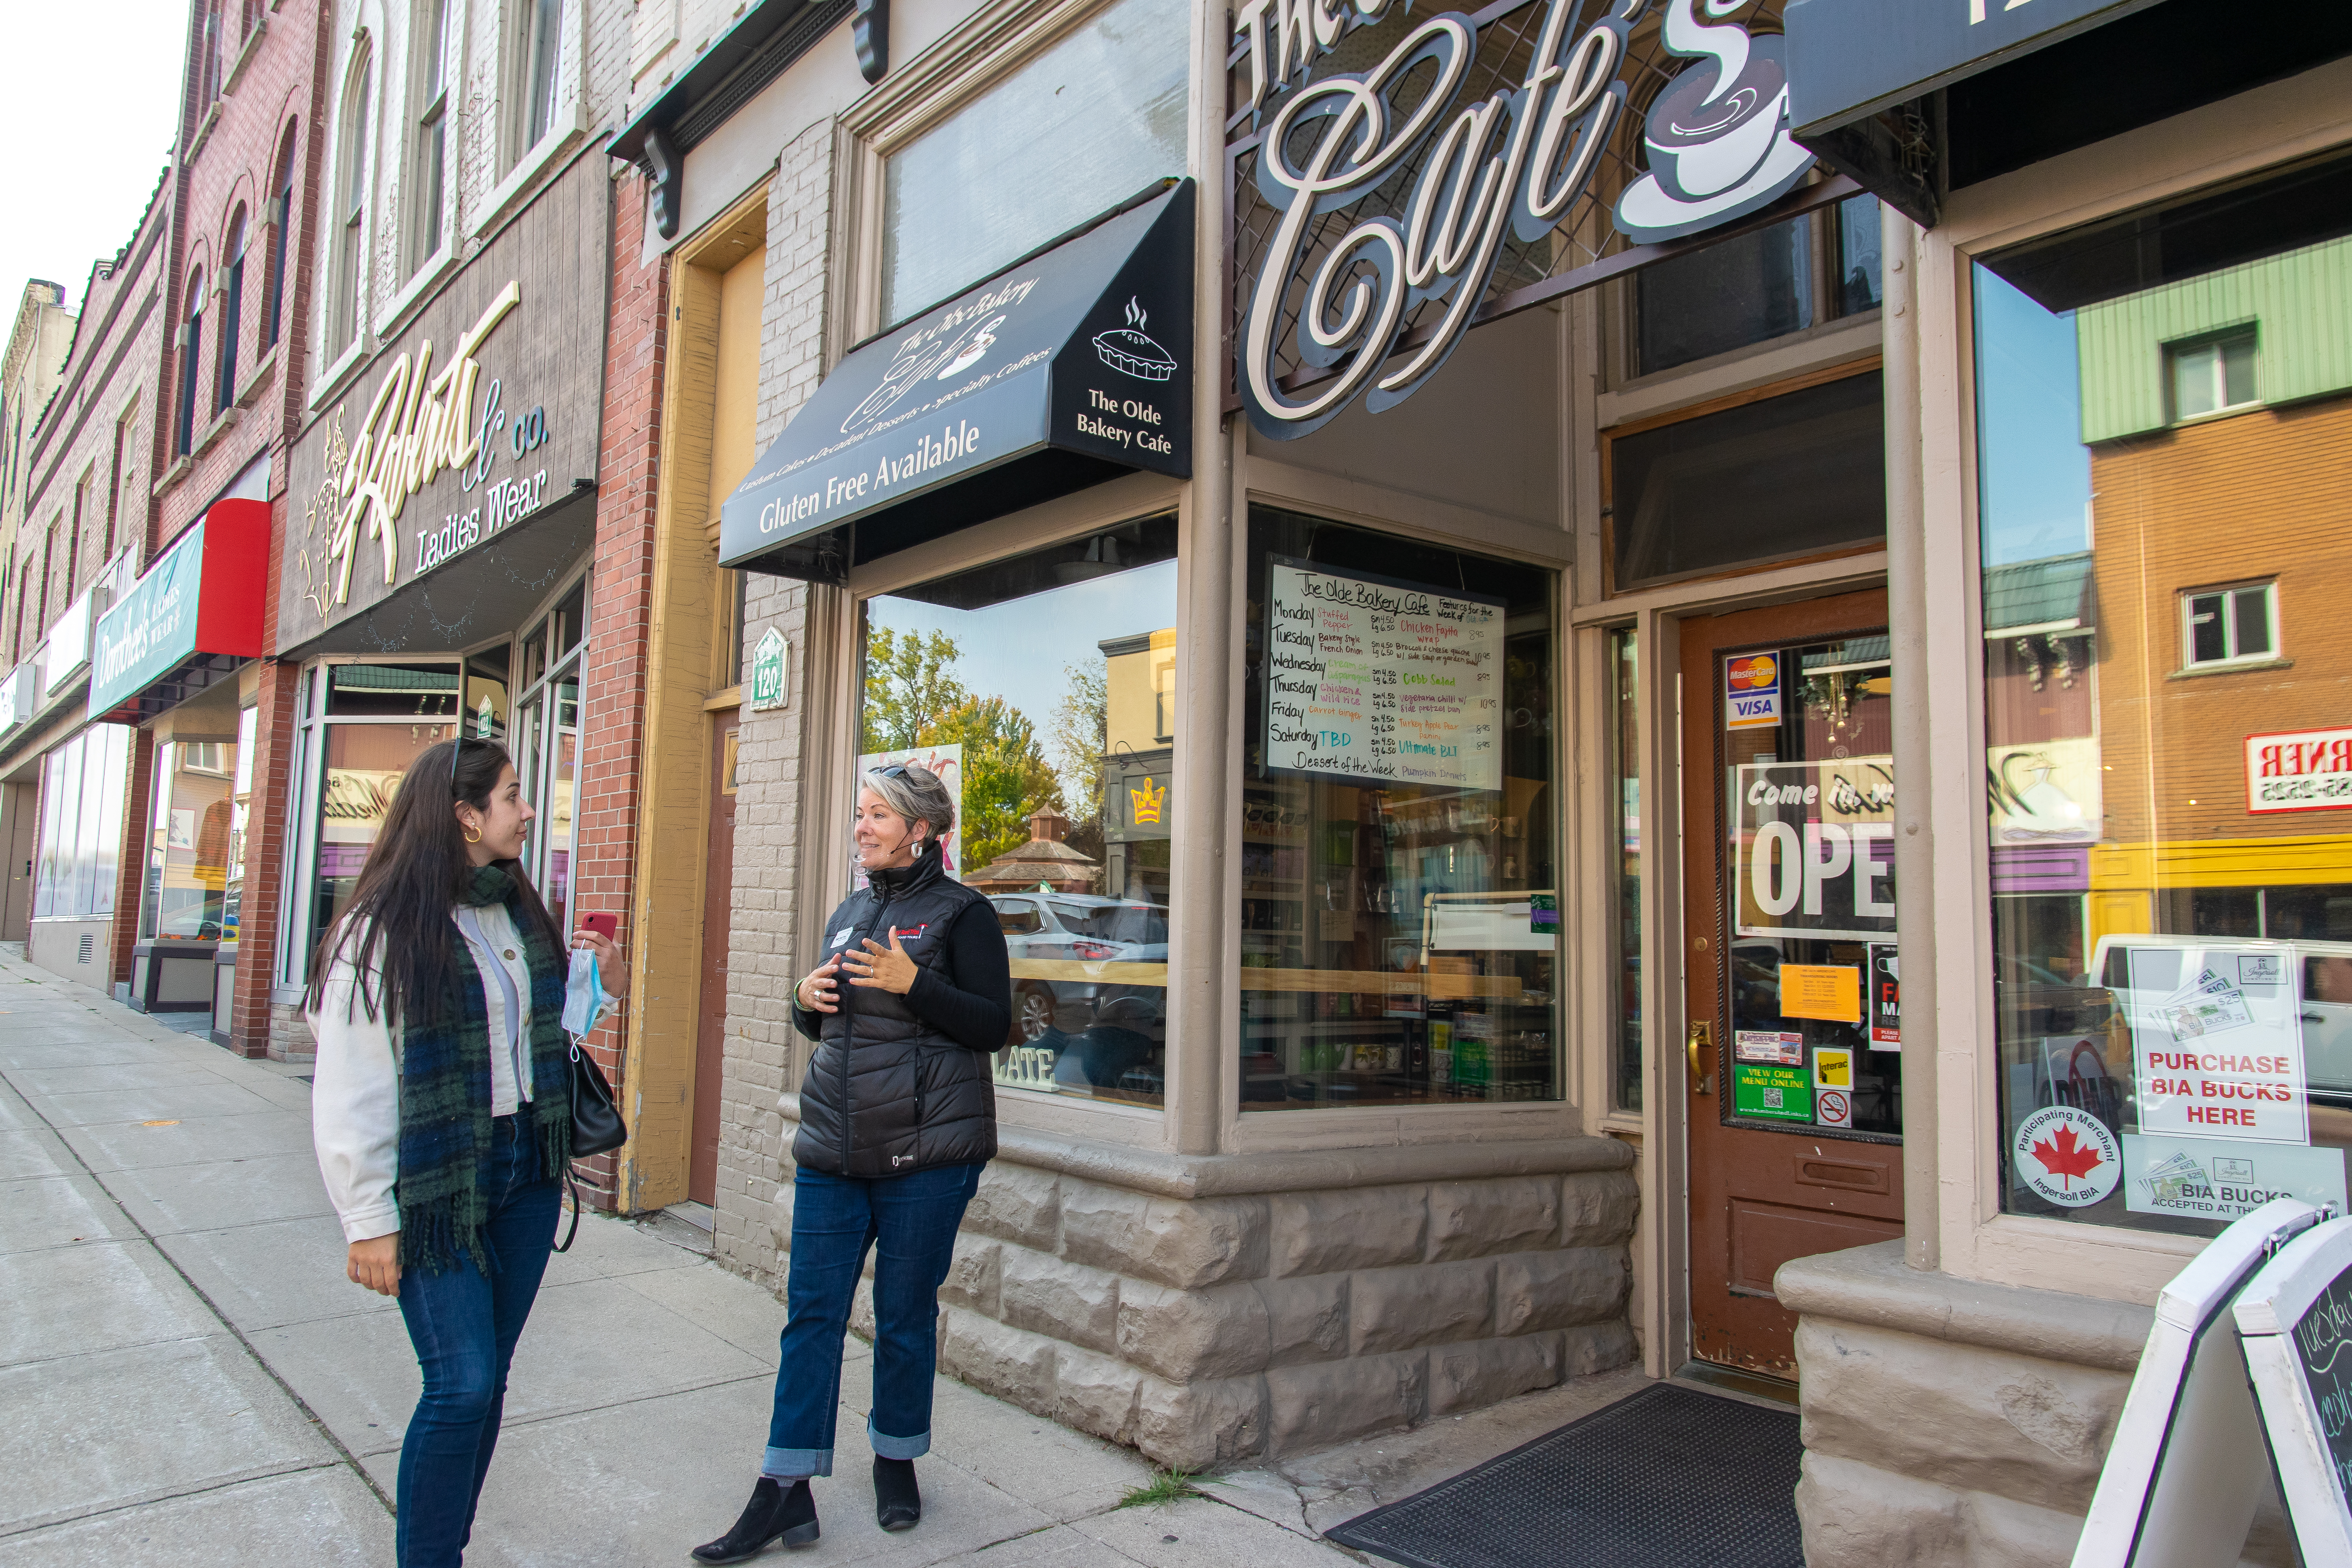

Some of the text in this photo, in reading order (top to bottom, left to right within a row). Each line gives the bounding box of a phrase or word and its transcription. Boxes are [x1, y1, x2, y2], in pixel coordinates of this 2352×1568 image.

[1089, 389, 1161, 425] The Olde
[739, 468, 773, 493] Custom
[777, 457, 809, 476] Cakes
[814, 429, 867, 460] Decadent
[869, 407, 920, 437] Desserts
[997, 347, 1052, 379] Coffees
[463, 378, 506, 493] &
[1077, 413, 1172, 454] Bakery Cafe
[759, 419, 980, 534] Gluten Free Available
[414, 469, 547, 575] Ladies Wear
[152, 583, 181, 623] LADIES
[1295, 573, 1430, 617] The Olde Bakery Cafe
[1274, 598, 1315, 628] Monday
[1317, 607, 1349, 621] Stuffed
[1439, 597, 1493, 617] Features for the
[1380, 615, 1395, 624] 4.50
[1437, 609, 1465, 622] Week of
[150, 615, 173, 647] WEAR
[1323, 619, 1353, 632] Pepper
[1400, 620, 1458, 639] Chicken Fajita
[1271, 623, 1315, 655] Tuesday
[1318, 632, 1361, 647] Bakery Style
[1319, 643, 1363, 655] French Onion
[1380, 649, 1394, 657] 6.50
[1395, 642, 1422, 652] Broccoli
[1450, 646, 1471, 657] quiche
[1271, 651, 1326, 681] Wednesday
[1408, 652, 1420, 660] side
[1442, 654, 1465, 666] garden
[1382, 669, 1397, 677] 4.50
[1403, 672, 1456, 687] Cobb Salad
[1730, 666, 1775, 680] MasterCard
[757, 665, 778, 698] 120
[1270, 673, 1317, 702] Thursday
[1320, 683, 1362, 696] Chicken &
[1343, 695, 1361, 706] rice
[1381, 691, 1395, 700] 4.50
[1381, 700, 1396, 708] 6.50
[1447, 705, 1461, 714] bun
[1734, 699, 1773, 716] VISA
[1271, 701, 1305, 727] Friday
[1338, 708, 1362, 723] Ginger
[1380, 714, 1395, 723] 4.50
[480, 715, 489, 732] 122
[1380, 725, 1395, 733] 6.50
[1398, 717, 1459, 732] Turkey Apple Pear
[1270, 723, 1318, 751] Saturday
[1319, 731, 1351, 747] TBD
[1381, 737, 1395, 746] 4.50
[1381, 747, 1396, 755] 6.50
[1399, 740, 1458, 758] Ultimate BLT
[1291, 750, 1398, 778] Dessert of the Week
[1402, 765, 1467, 781] Pumpkin Donuts
[1747, 780, 1819, 806] Come
[1751, 821, 1895, 917] OPE
[2217, 993, 2240, 1006] $25
[1819, 1060, 1848, 1072] Interac
[2149, 1052, 2291, 1075] PURCHASE
[1748, 1068, 1795, 1079] VIEW OUR
[1741, 1077, 1805, 1089] MENU ONLINE
[2151, 1078, 2292, 1102] BIA BUCKS
[2187, 1106, 2257, 1127] HERE
[2018, 1110, 2116, 1162] Participating Merchant
[2187, 1171, 2203, 1179] $25
[2033, 1177, 2100, 1201] Ingersoll BIA
[2181, 1183, 2215, 1200] BIA
[2151, 1197, 2213, 1212] ACCEPTED
[2217, 1204, 2232, 1213] AT
